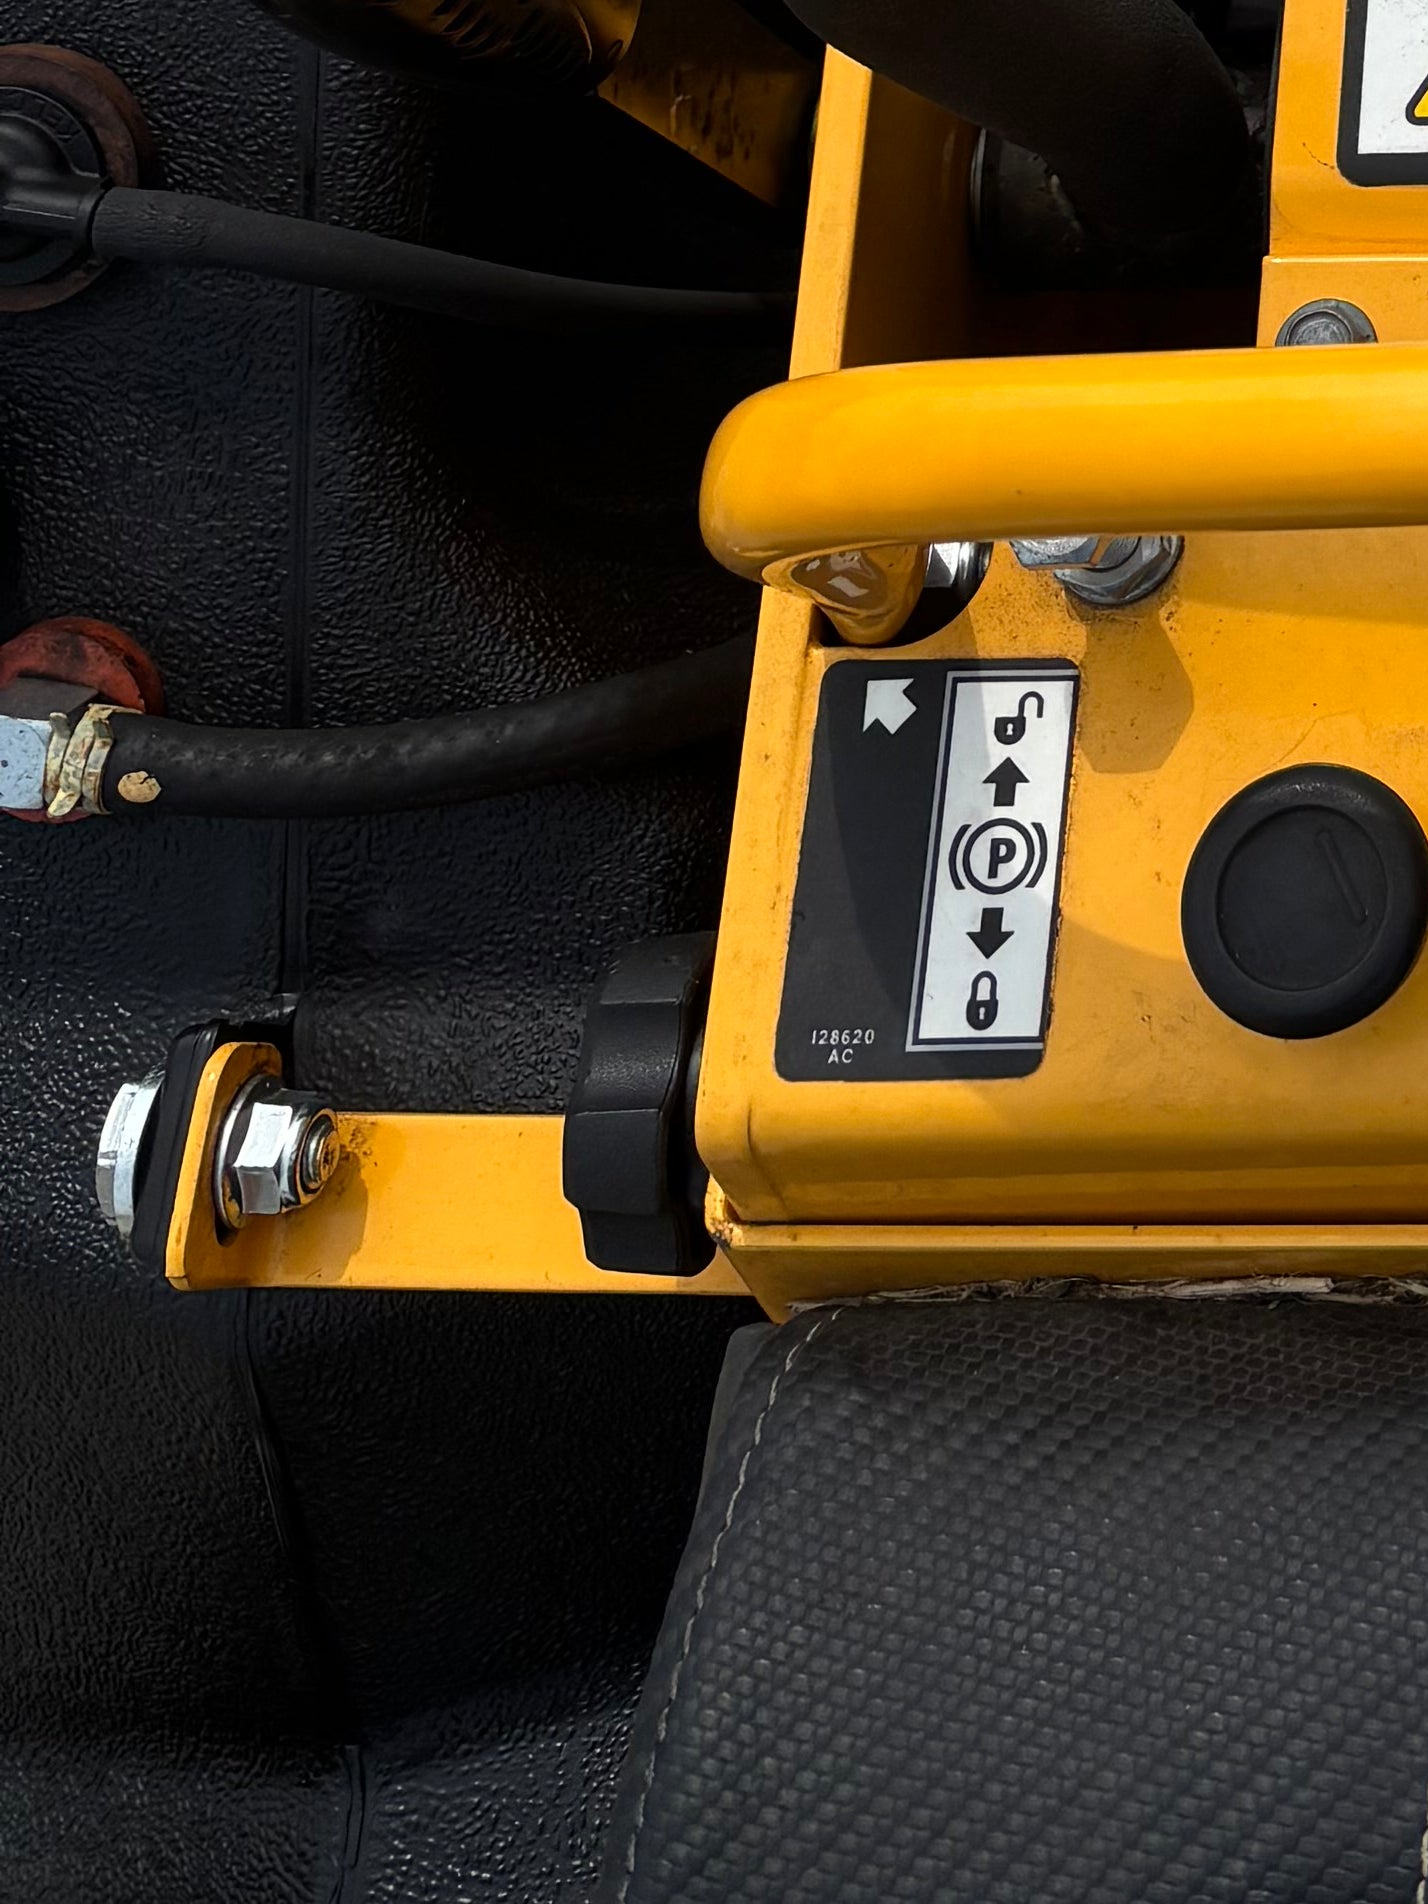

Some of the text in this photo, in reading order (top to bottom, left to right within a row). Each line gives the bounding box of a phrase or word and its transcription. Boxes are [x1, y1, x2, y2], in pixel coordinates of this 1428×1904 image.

[987, 837, 1017, 880] P
[811, 1028, 876, 1046] 128620
[827, 1048, 854, 1065] AC
